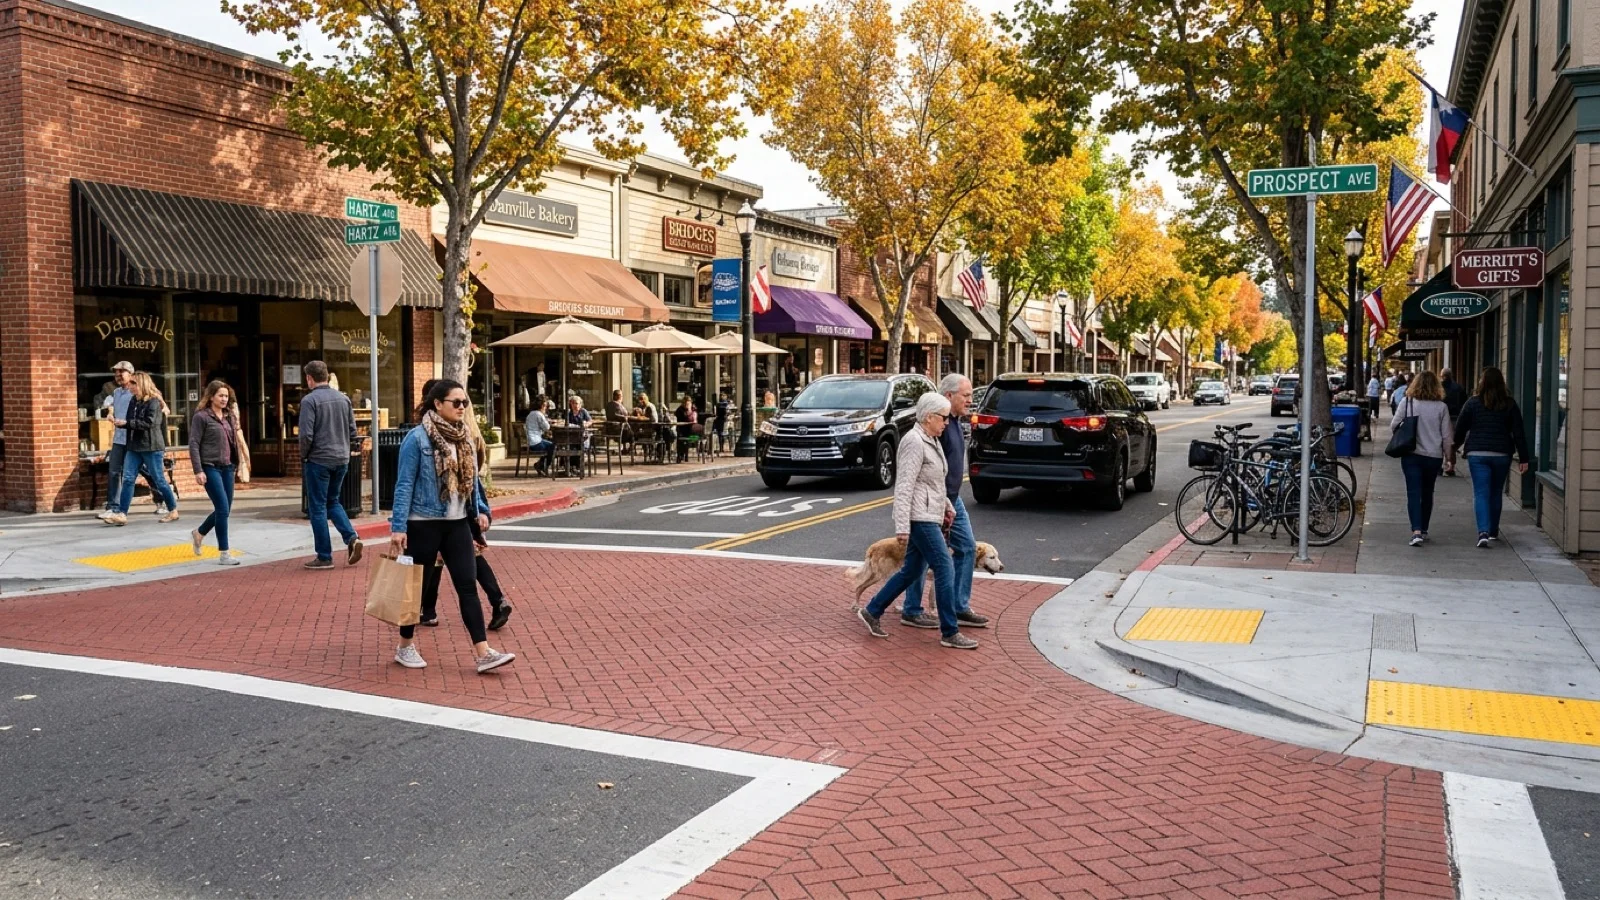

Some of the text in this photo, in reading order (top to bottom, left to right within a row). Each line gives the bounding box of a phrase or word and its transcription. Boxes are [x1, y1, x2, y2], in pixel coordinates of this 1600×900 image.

[1253, 171, 1372, 192] PROSPECT AVE
[348, 200, 380, 218] HARTZ
[538, 204, 575, 231] Bakery
[348, 225, 379, 241] HARTZ
[1461, 253, 1538, 268] MERRITT'S
[1477, 269, 1520, 283] GIFTS
[94, 314, 174, 342] Danville
[115, 336, 158, 353] Bakery
[638, 495, 844, 518] STOP
